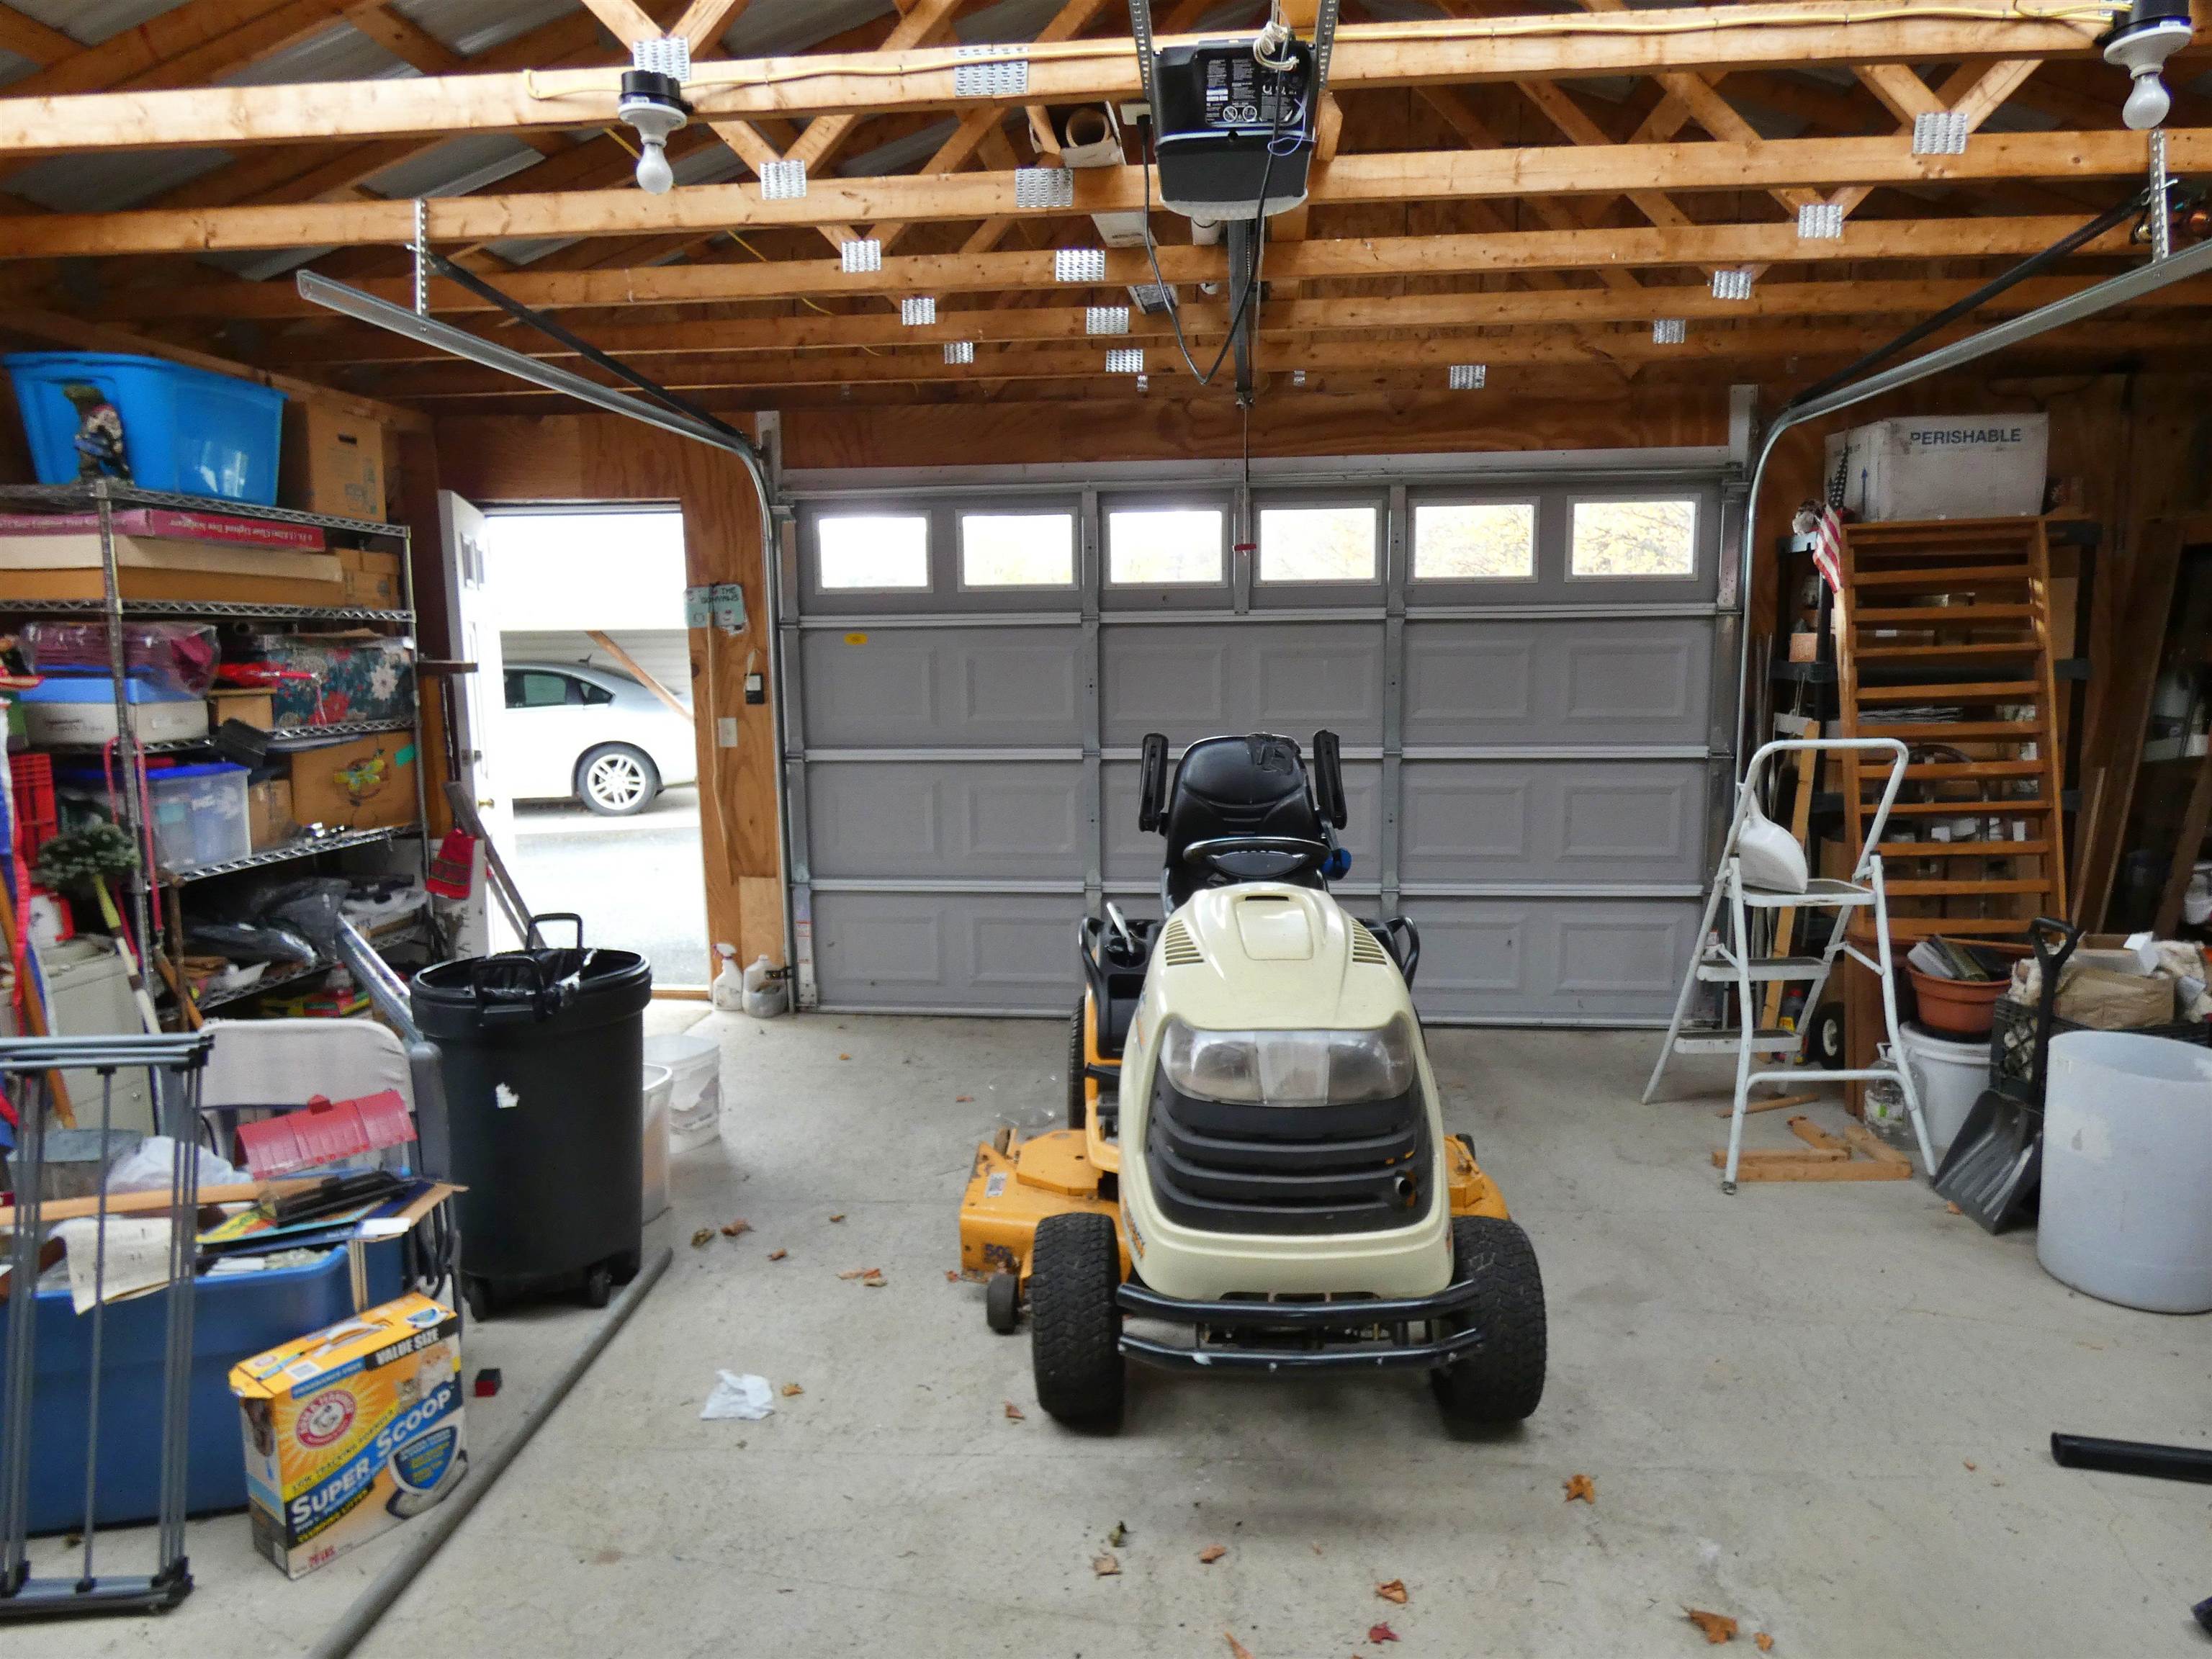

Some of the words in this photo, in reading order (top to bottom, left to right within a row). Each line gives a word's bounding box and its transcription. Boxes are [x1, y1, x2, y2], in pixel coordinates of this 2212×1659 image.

[1910, 428, 2022, 445] PERISHABLE
[375, 1338, 413, 1366] VALUE
[413, 1326, 440, 1351] SIZE
[291, 1457, 370, 1524] SUPER
[376, 1388, 451, 1458] SCOOP
